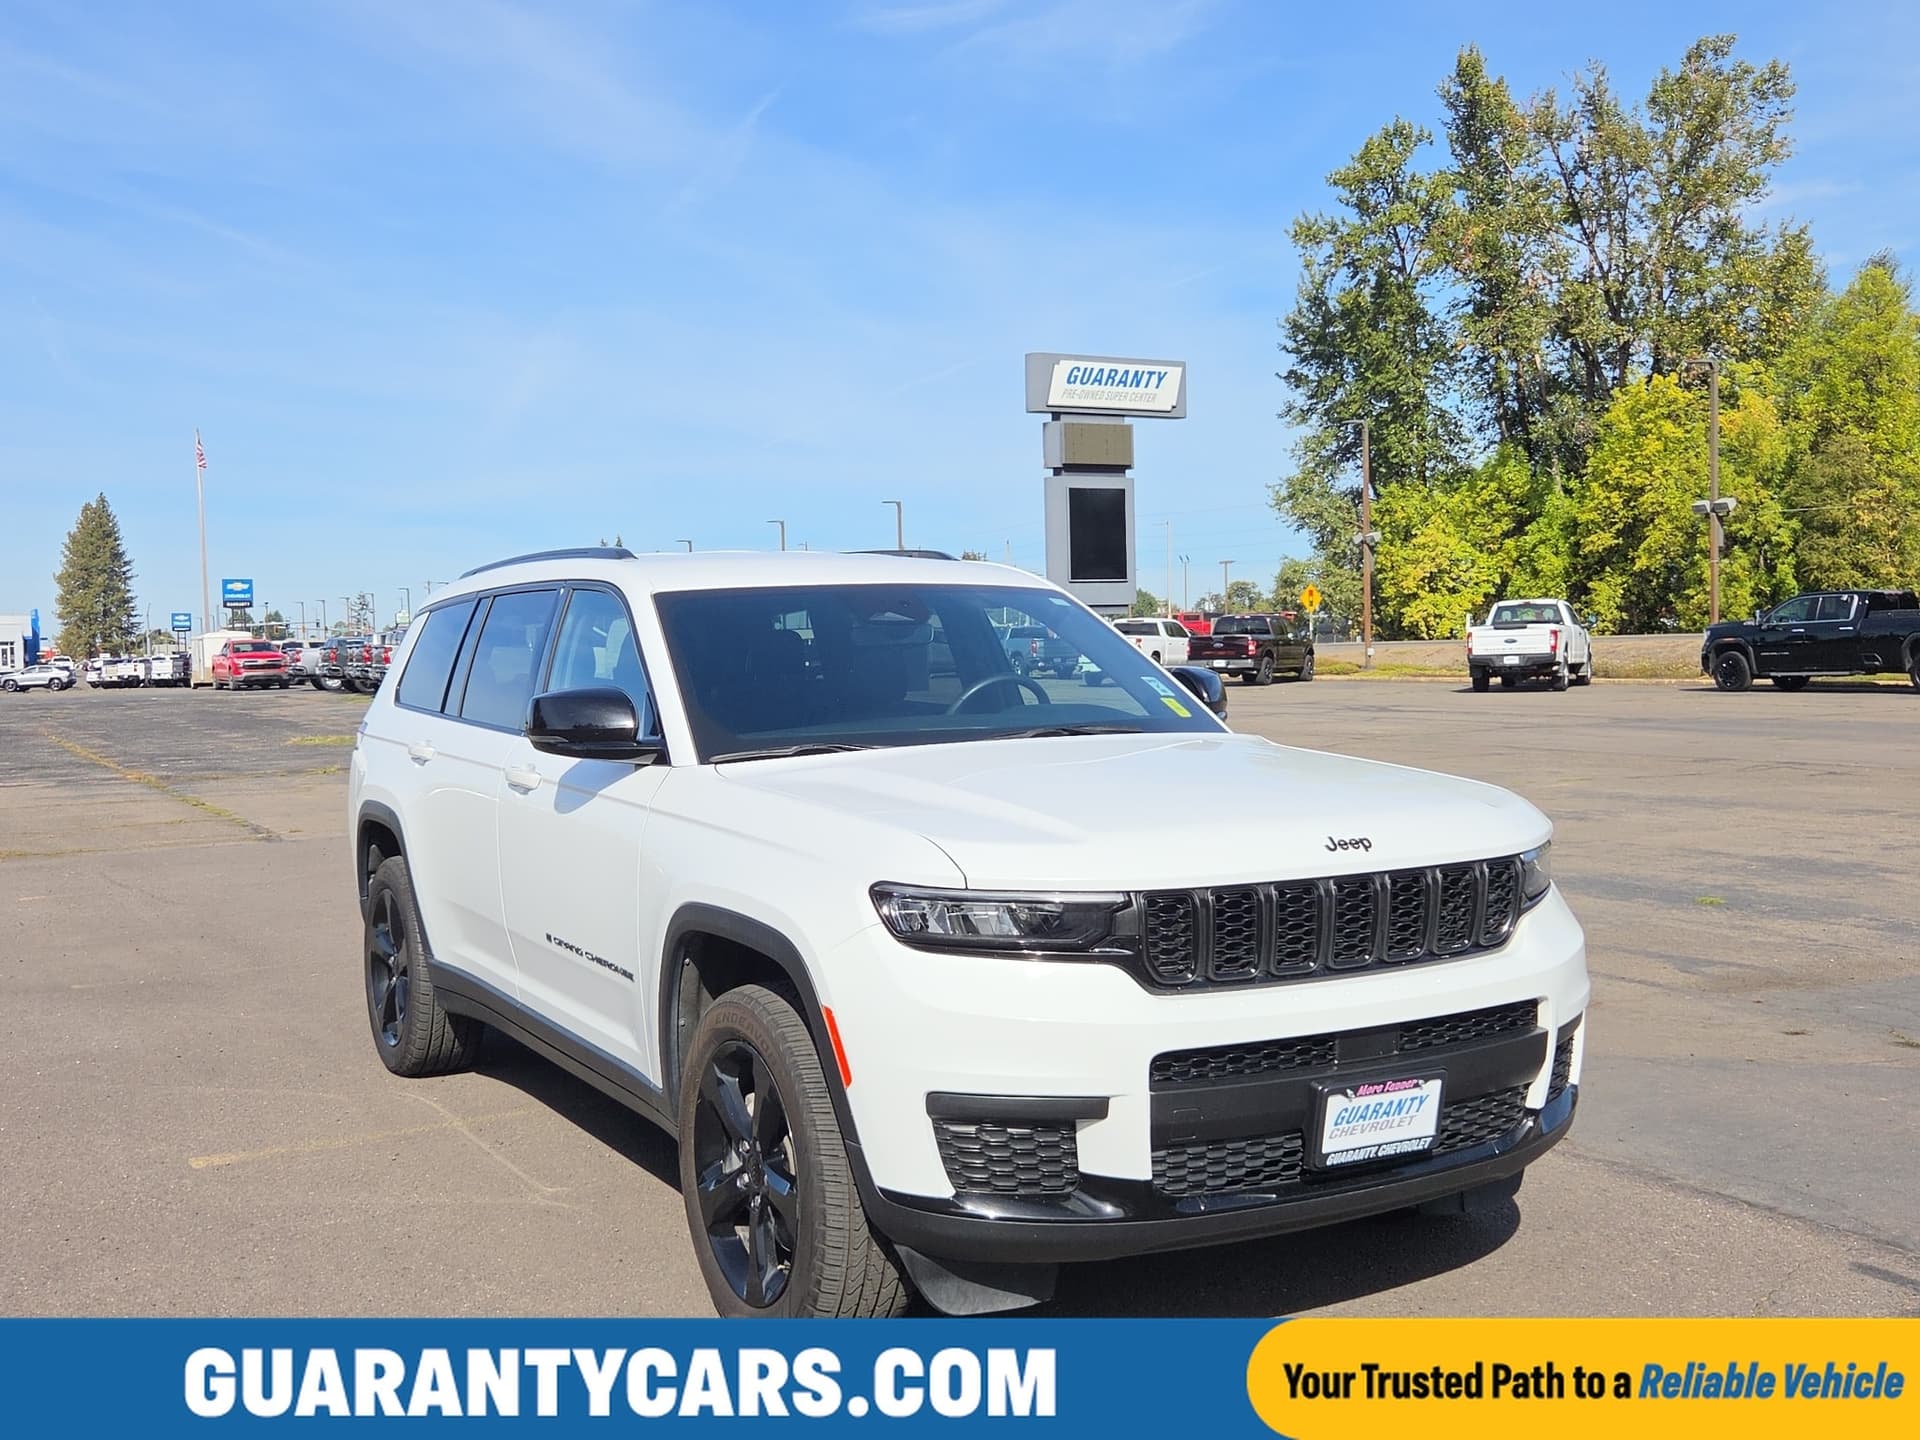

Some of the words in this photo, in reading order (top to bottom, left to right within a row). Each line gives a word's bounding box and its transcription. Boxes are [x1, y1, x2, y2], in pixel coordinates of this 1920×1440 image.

[1066, 366, 1168, 390] GUARANTY
[1061, 388, 1105, 401] PRE-OWNED
[1105, 390, 1129, 402] SUPER
[1129, 391, 1158, 404] CENTER
[1324, 836, 1373, 852] Jeep
[1333, 1094, 1429, 1127] GUARANTY
[1328, 1114, 1417, 1140] CHEVROLET
[1378, 1137, 1433, 1156] CHEVROLET
